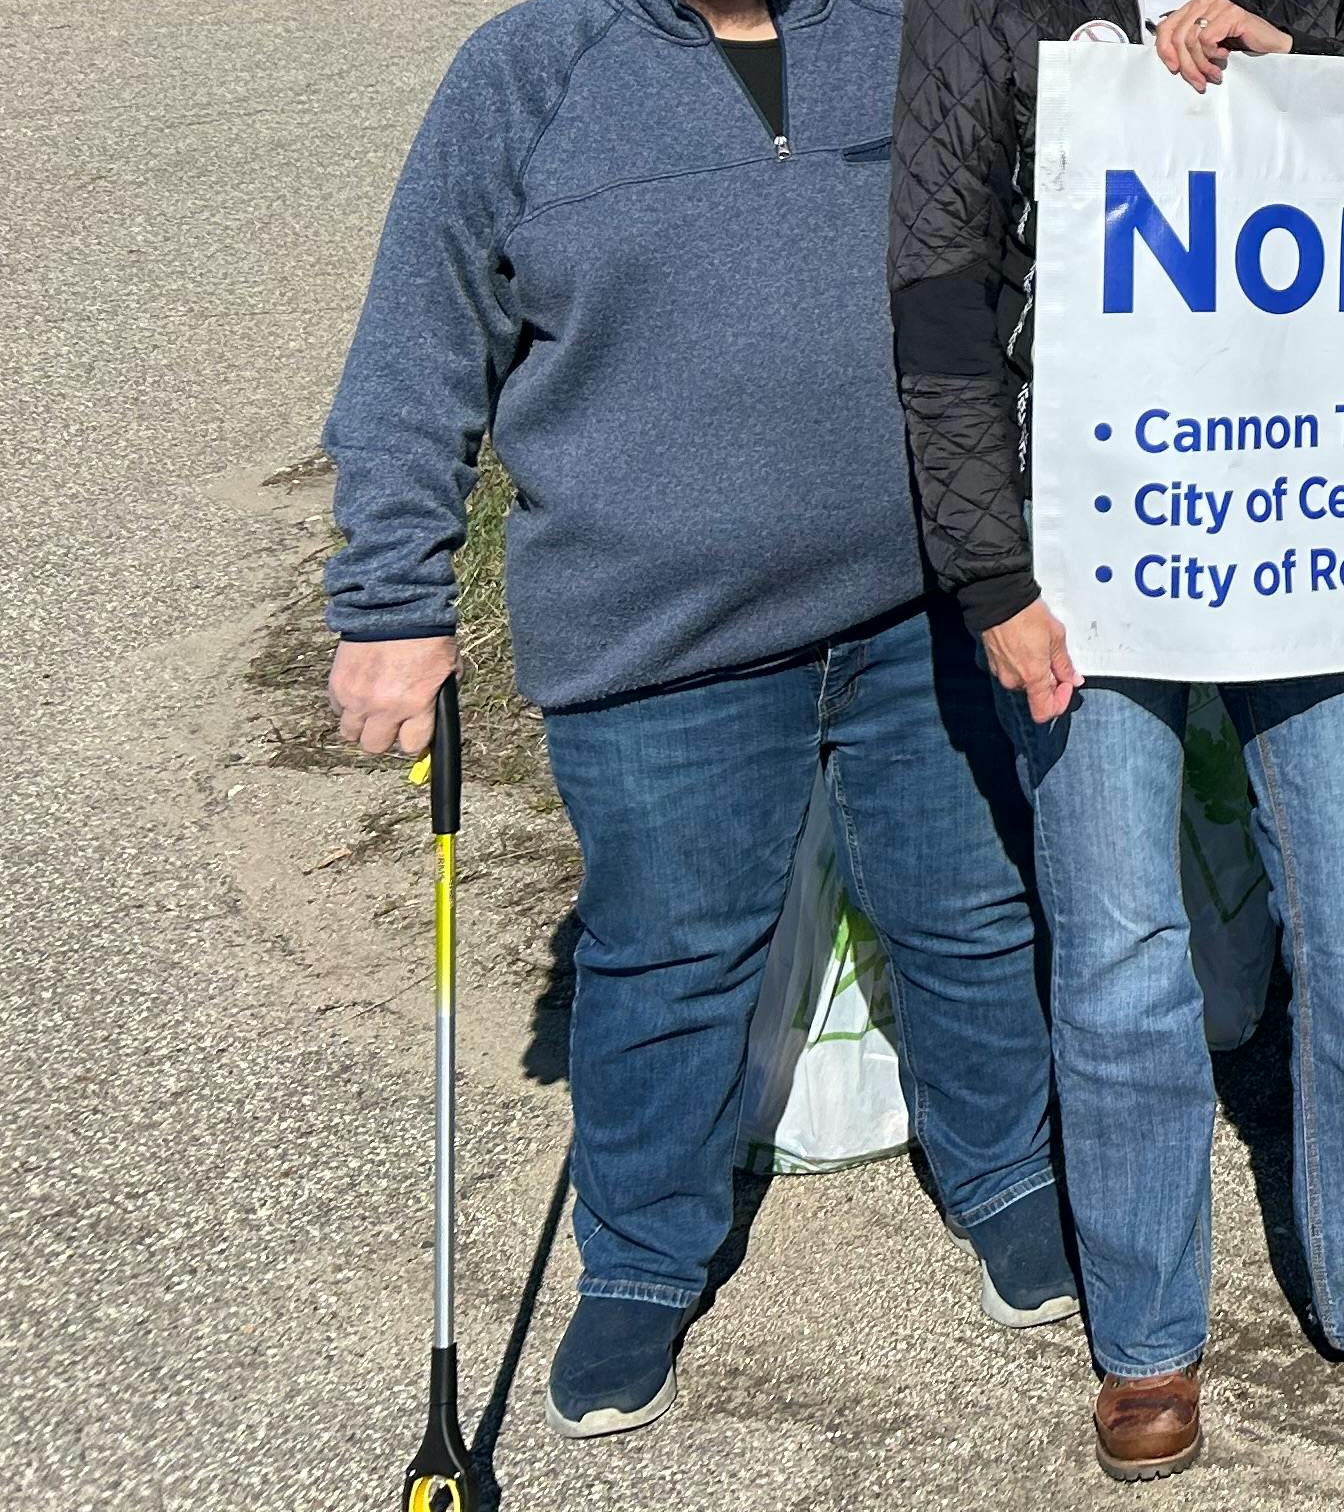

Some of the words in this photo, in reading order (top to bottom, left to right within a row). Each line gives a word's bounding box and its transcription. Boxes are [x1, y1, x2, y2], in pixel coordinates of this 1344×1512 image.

[1135, 408, 1319, 454] Cannon
[1134, 481, 1233, 535] City
[1246, 476, 1288, 524] of
[1134, 554, 1238, 609] City
[1253, 548, 1296, 597] of
